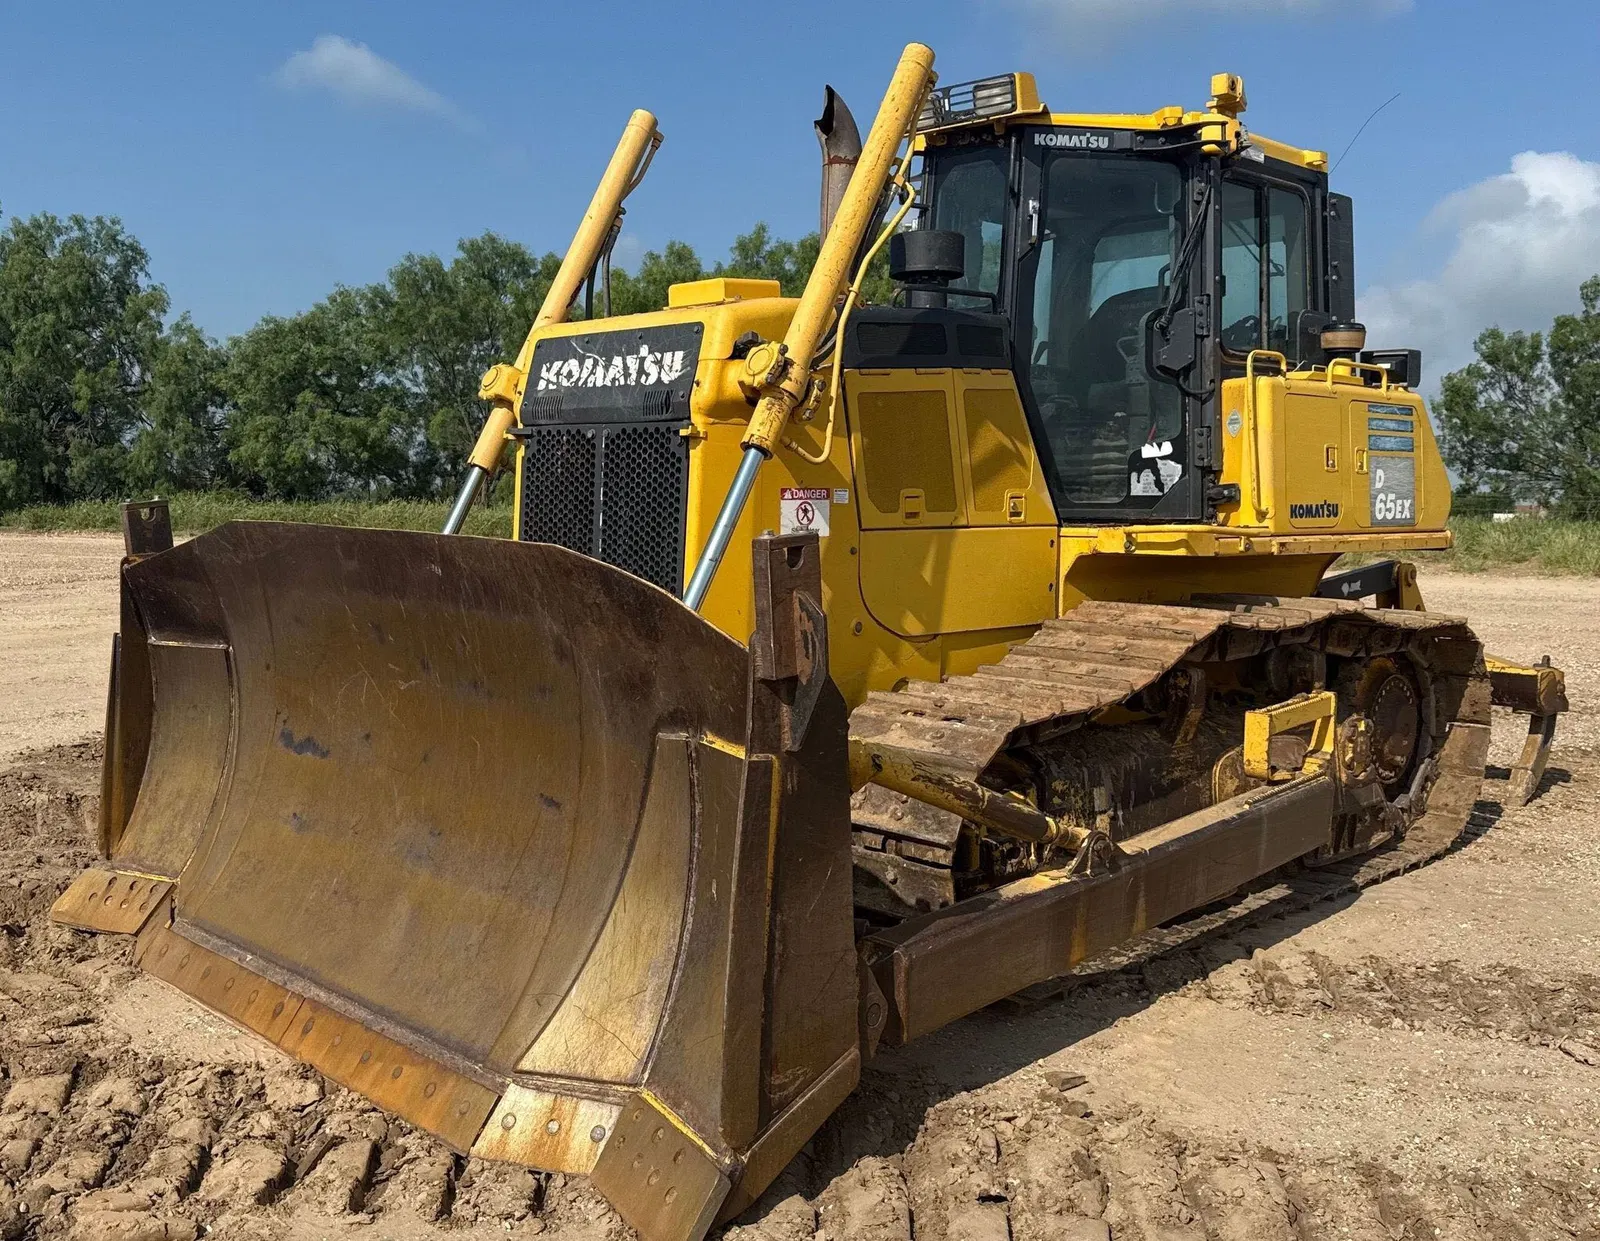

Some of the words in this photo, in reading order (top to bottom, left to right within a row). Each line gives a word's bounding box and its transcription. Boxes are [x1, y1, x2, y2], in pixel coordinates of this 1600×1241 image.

[1034, 132, 1109, 149] KOMATSU
[537, 344, 684, 391] KOMATSU
[1375, 468, 1385, 489] D
[793, 489, 827, 499] DANGER
[1290, 500, 1339, 519] KOMATSU
[1375, 492, 1412, 520] 65EX
